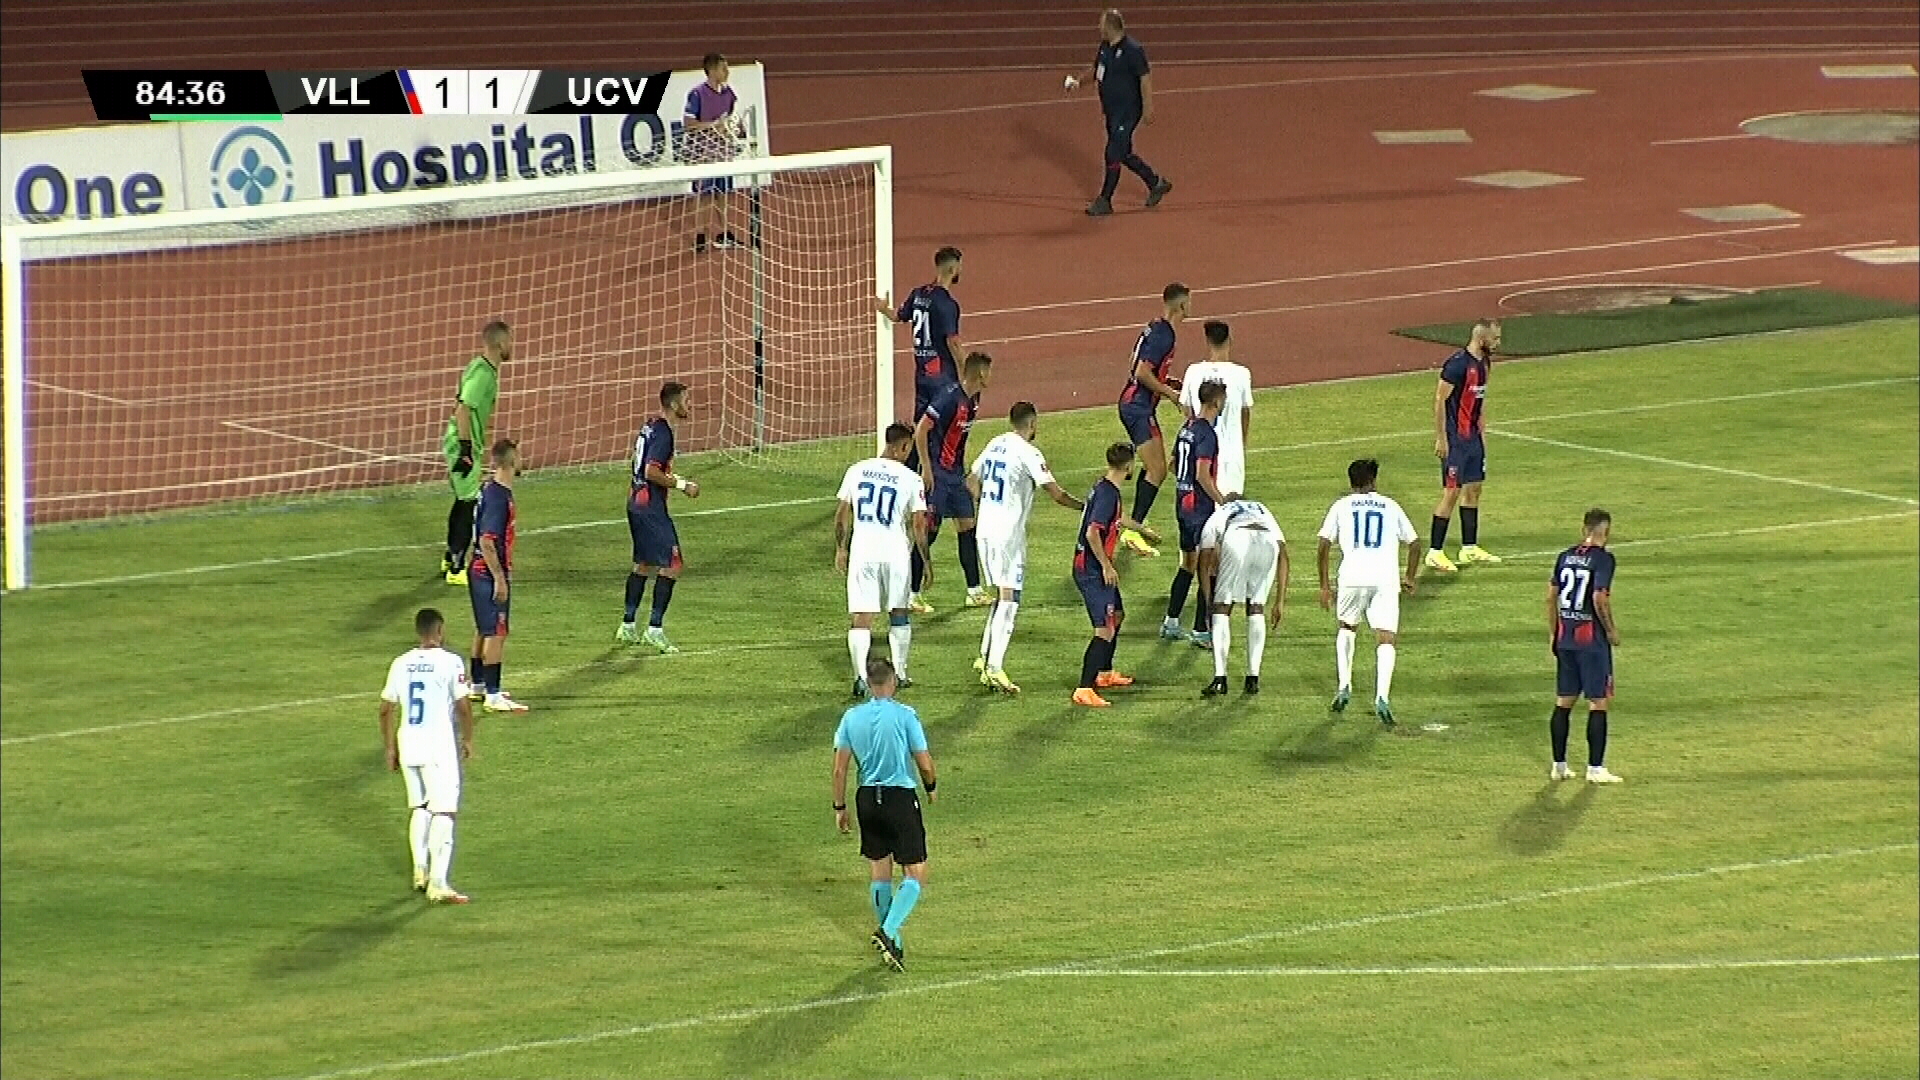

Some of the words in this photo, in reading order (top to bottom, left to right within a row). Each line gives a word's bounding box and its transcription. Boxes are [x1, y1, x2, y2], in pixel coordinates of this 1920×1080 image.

[318, 115, 597, 198] Hospital
[14, 163, 165, 224] One
[913, 309, 932, 347] 21
[857, 481, 898, 527] 20
[1352, 510, 1384, 549] 10
[1560, 568, 1590, 610] 27
[408, 681, 425, 724] 6
